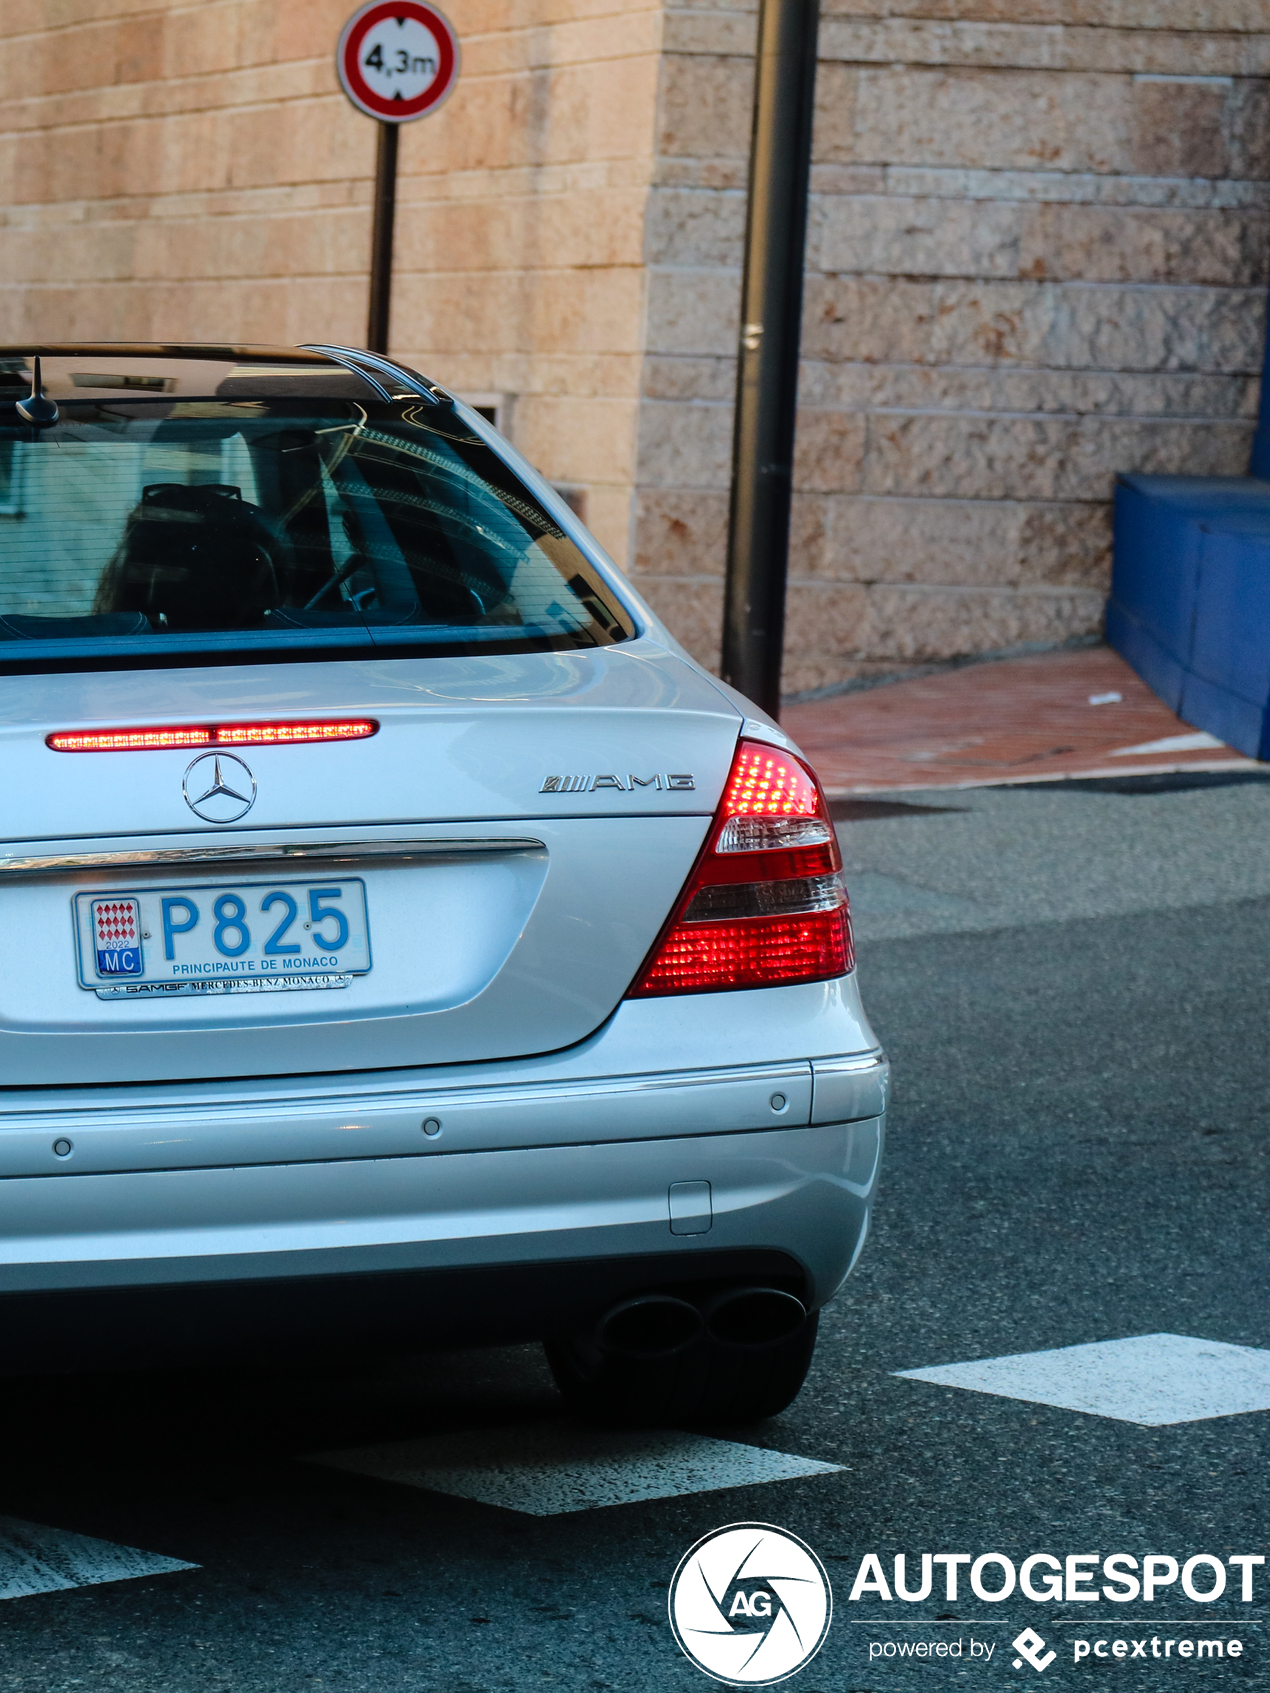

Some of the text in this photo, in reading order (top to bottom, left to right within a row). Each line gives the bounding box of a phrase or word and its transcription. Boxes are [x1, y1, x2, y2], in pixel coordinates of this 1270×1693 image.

[365, 42, 435, 77] 4,3m
[589, 774, 696, 791] AMG
[160, 888, 349, 961] P825
[105, 940, 130, 950] 2022
[105, 951, 134, 971] MC
[172, 956, 339, 975] PRINCIPAUTE DE MONACO
[191, 977, 279, 990] MERCEDES-BENZ
[283, 975, 330, 985] MONACO
